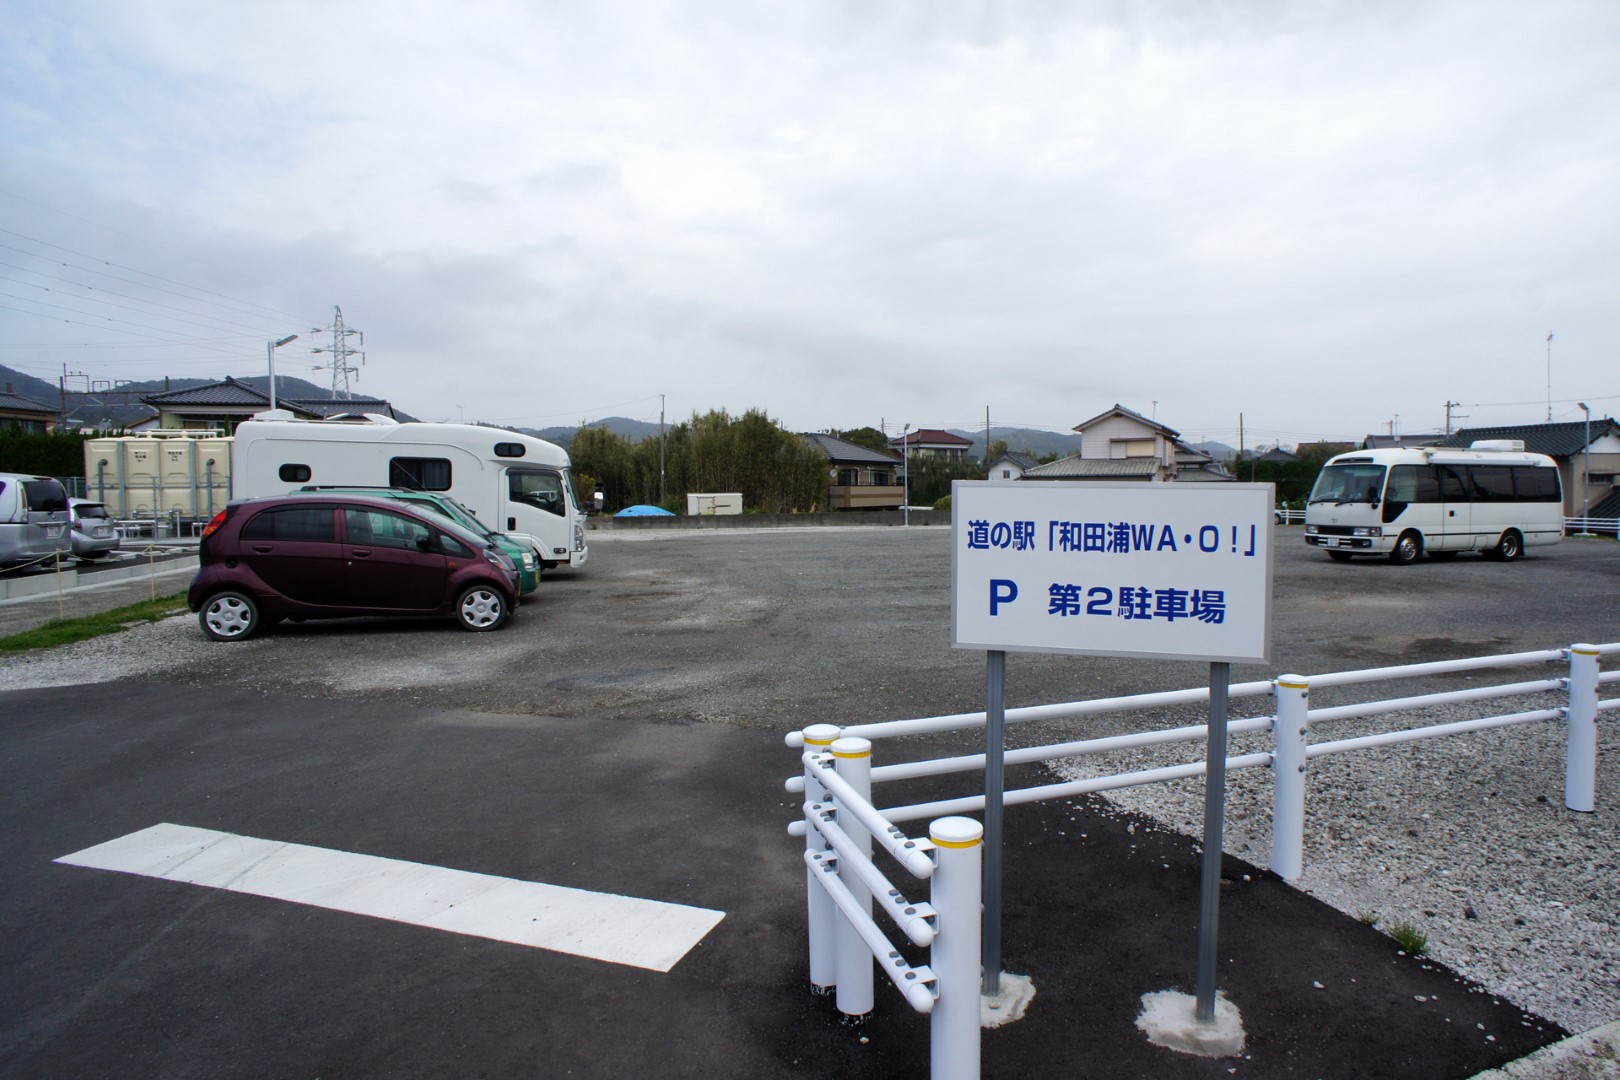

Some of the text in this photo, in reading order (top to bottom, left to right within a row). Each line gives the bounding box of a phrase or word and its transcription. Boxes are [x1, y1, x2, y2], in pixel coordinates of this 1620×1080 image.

[989, 578, 1228, 625] P 第2駐車場
